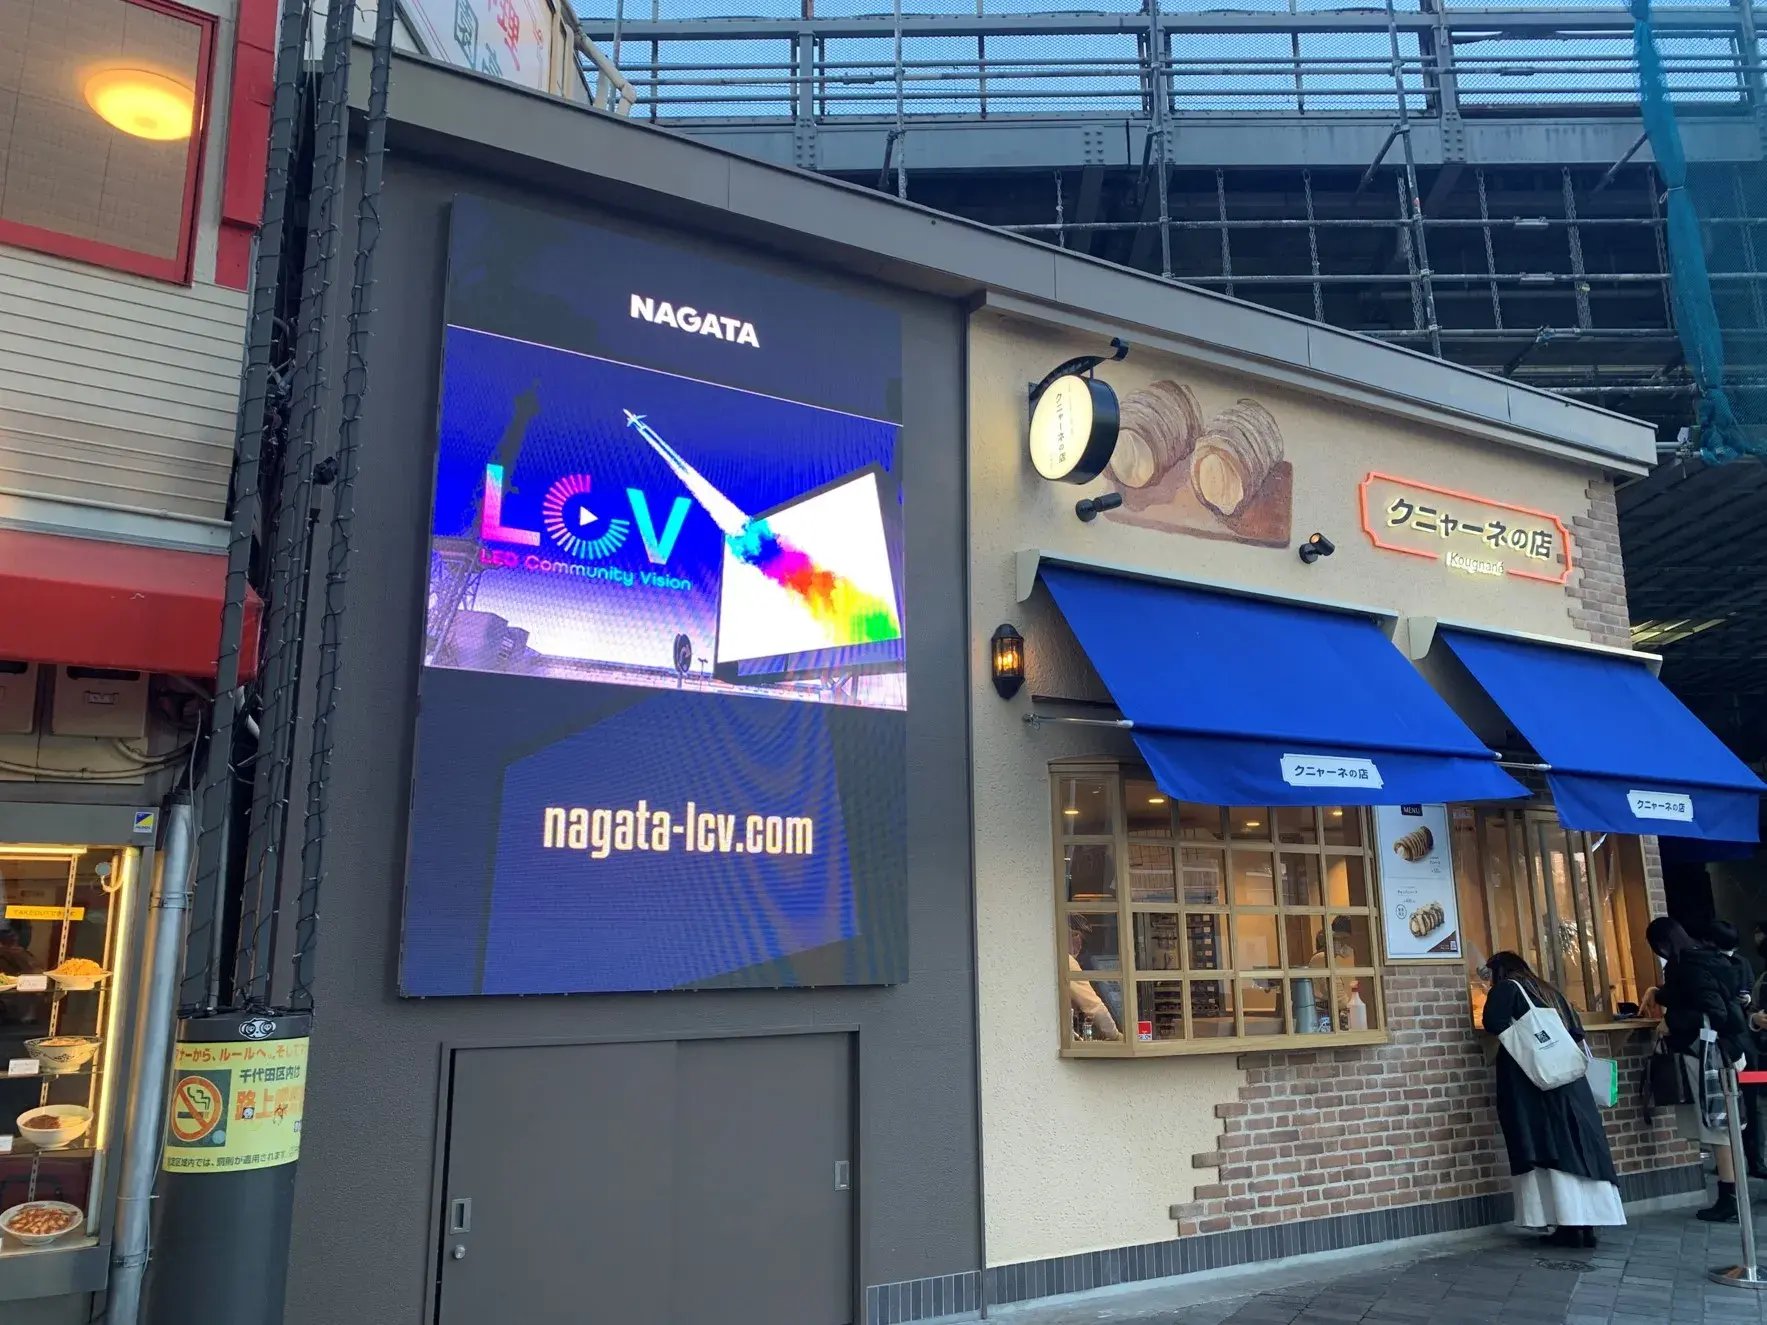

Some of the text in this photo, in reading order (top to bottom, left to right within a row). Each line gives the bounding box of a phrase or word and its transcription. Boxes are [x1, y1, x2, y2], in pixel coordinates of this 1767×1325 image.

[630, 293, 761, 348] NAGATA
[1056, 393, 1066, 463] クニャーネの店
[481, 463, 692, 565] LCV
[1388, 498, 1553, 559] クニャーネの店
[480, 548, 693, 591] LED Community Vision
[1294, 764, 1369, 780] クニャーネの店
[543, 799, 814, 859] nagata-lcv.com
[1403, 806, 1421, 814] MENU
[1637, 799, 1686, 813] クニャーネの店
